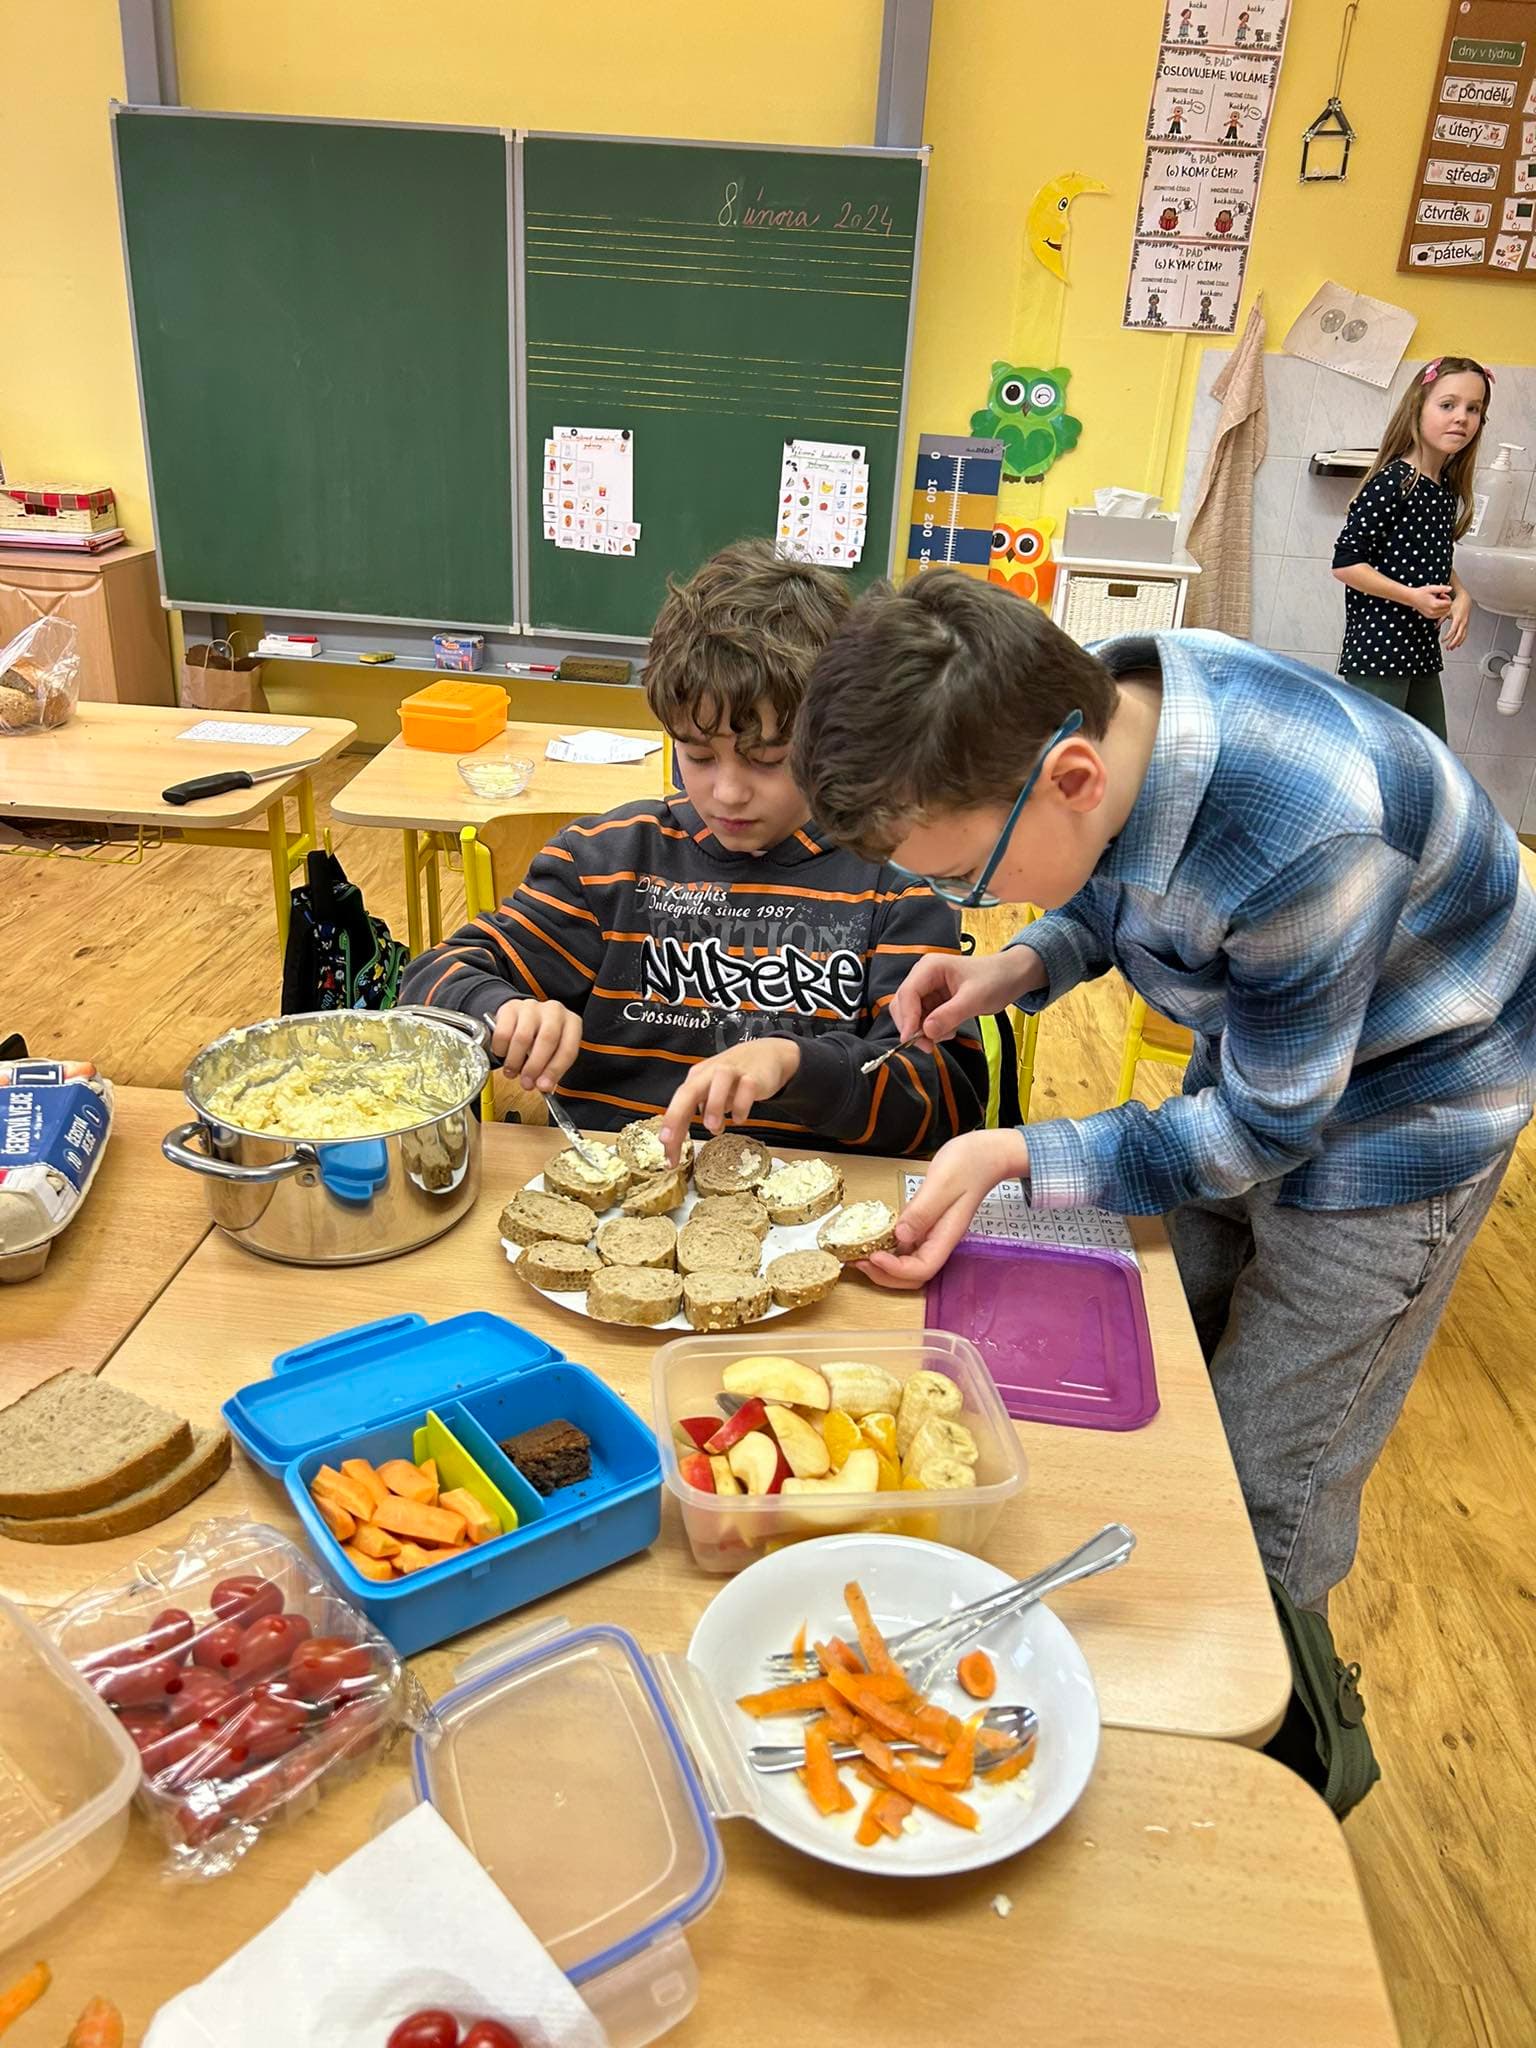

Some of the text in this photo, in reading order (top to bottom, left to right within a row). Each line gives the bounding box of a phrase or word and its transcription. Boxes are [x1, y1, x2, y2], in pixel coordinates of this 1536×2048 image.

[1458, 45, 1516, 61] dny v týdnu
[1458, 85, 1510, 103] pondělí
[1449, 121, 1483, 142] úterý
[1166, 165, 1179, 177] (o)
[1181, 166, 1209, 177] KOM?
[1446, 167, 1489, 184] středa
[717, 182, 737, 227] 8.
[833, 202, 893, 237] 2024
[1423, 205, 1471, 222] čtvrtek
[1434, 244, 1472, 263] pátek
[1155, 258, 1167, 269] (s)
[931, 451, 941, 460] 0
[926, 478, 938, 503] 100
[922, 513, 934, 538] 200
[919, 548, 931, 572] 300
[665, 884, 728, 906] Knights
[649, 895, 795, 919] Integrale since 1987
[19, 1071, 56, 1080] L
